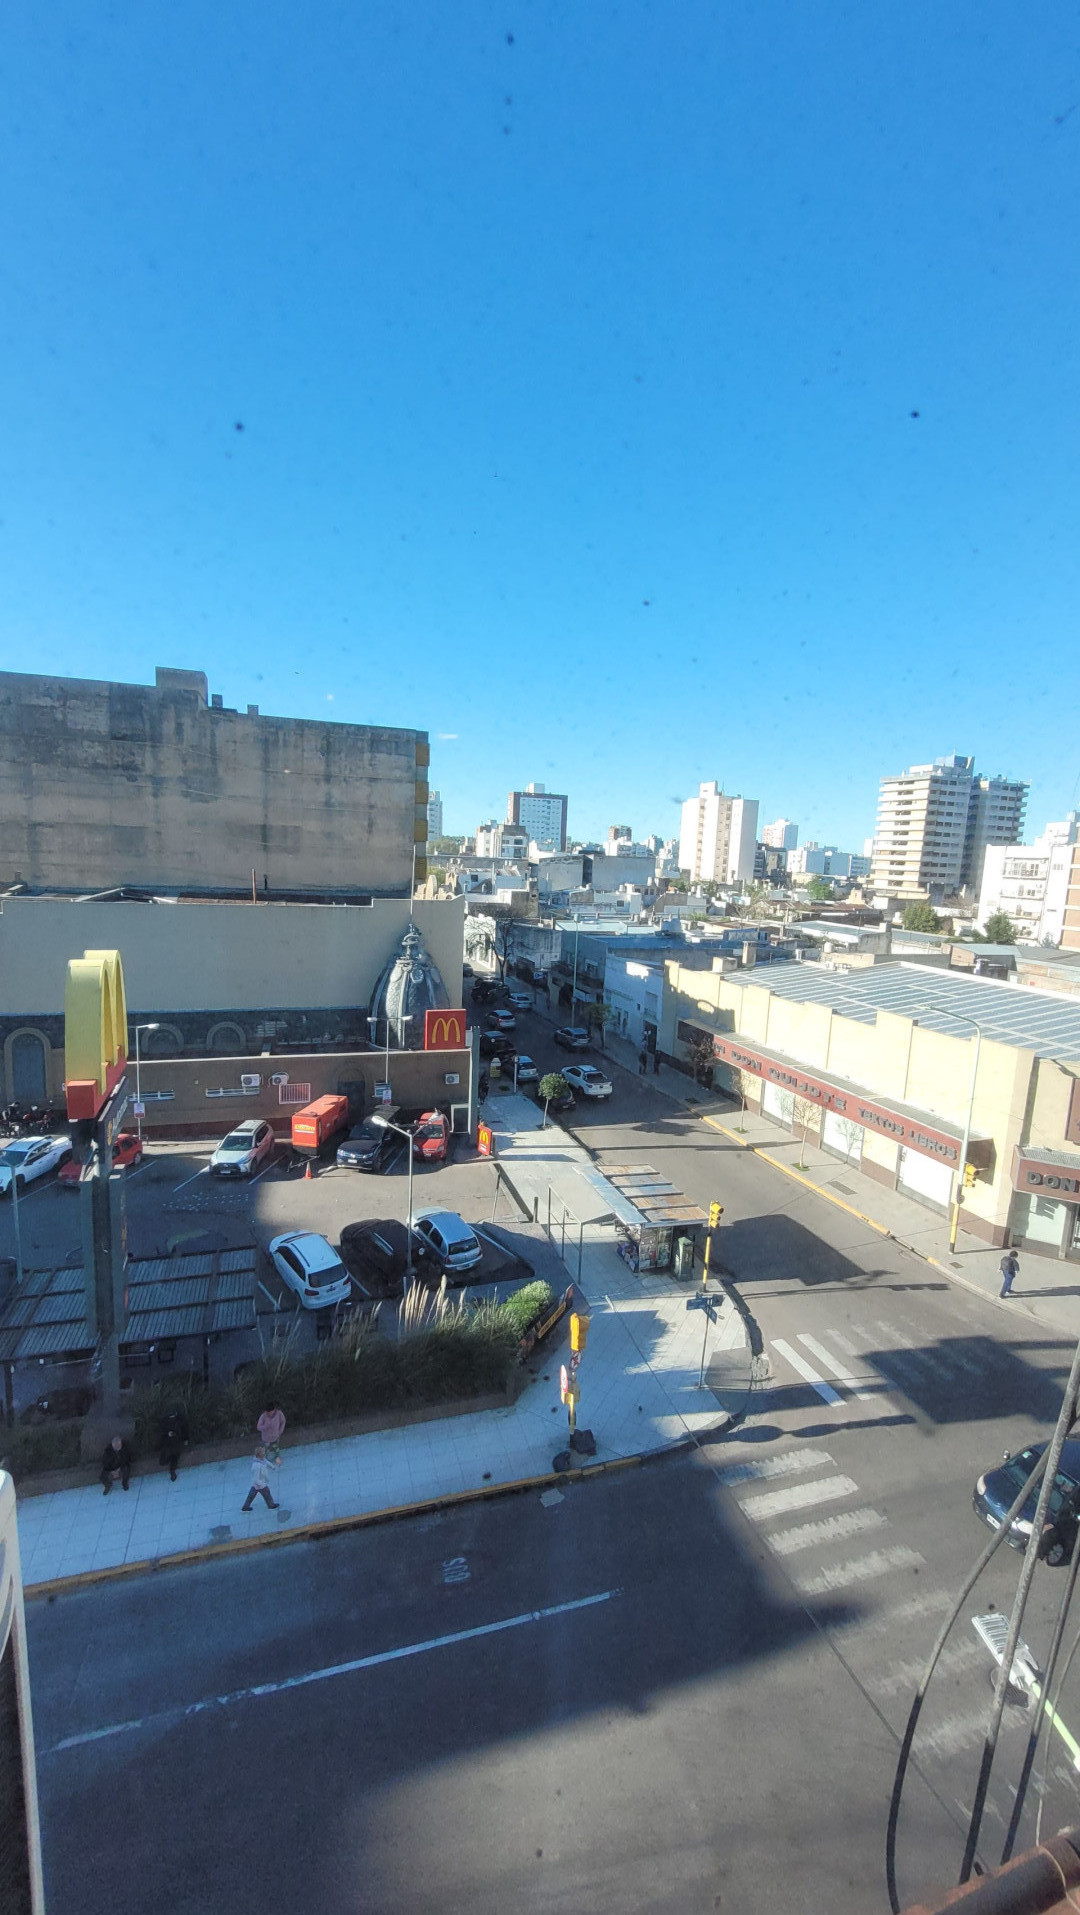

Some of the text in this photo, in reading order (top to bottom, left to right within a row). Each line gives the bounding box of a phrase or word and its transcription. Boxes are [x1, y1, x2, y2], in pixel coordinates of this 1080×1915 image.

[431, 1017, 461, 1043] M
[732, 1051, 762, 1071] DON
[768, 1067, 847, 1110] QUIJOTE
[909, 1130, 957, 1160] LIBROS
[1027, 1172, 1079, 1193] DON
[440, 1556, 472, 1583] BUS
